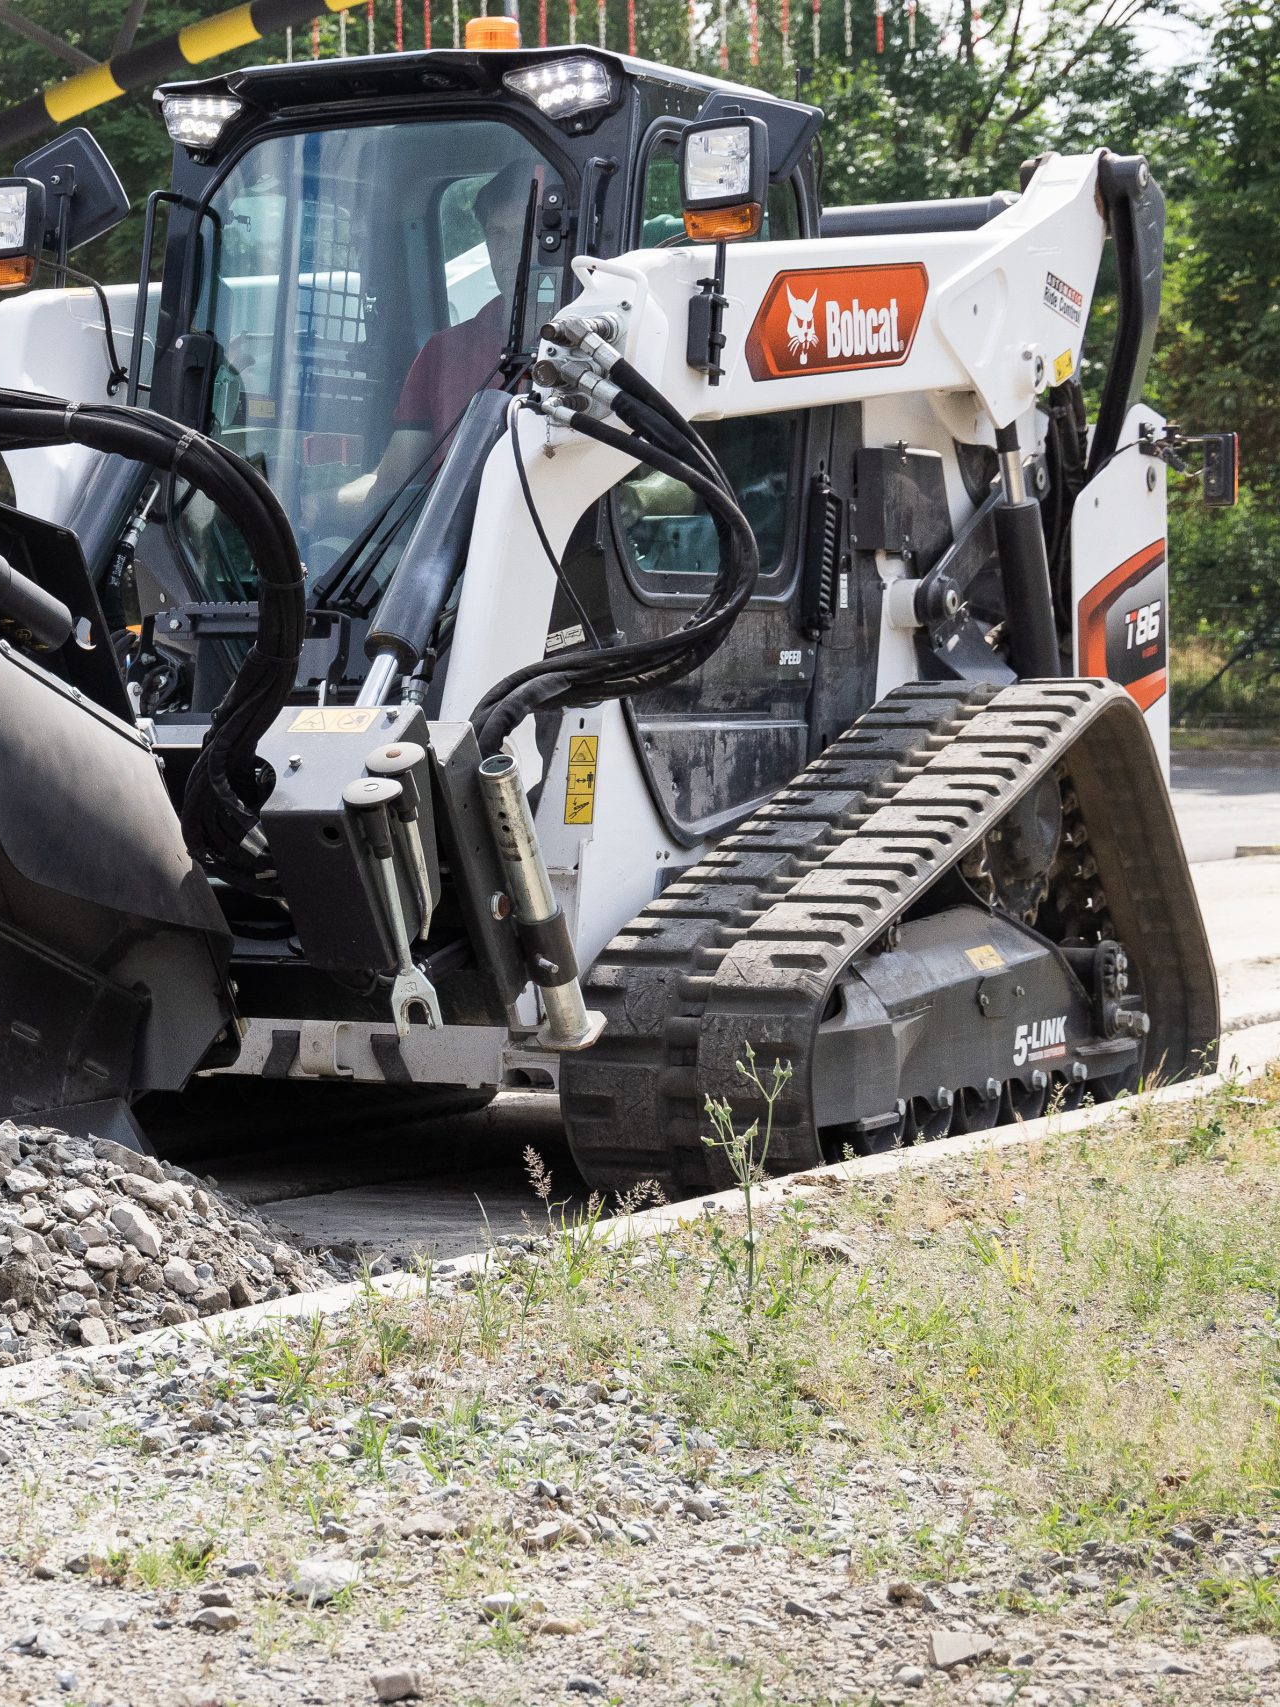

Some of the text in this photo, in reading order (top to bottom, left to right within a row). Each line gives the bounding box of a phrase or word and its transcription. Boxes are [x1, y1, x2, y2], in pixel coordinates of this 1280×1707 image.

[825, 298, 900, 358] Bobcat
[1044, 286, 1081, 322] Ride Control
[1125, 600, 1161, 650] T86
[779, 650, 802, 665] SPEED
[1013, 1015, 1068, 1066] 5-LINK
